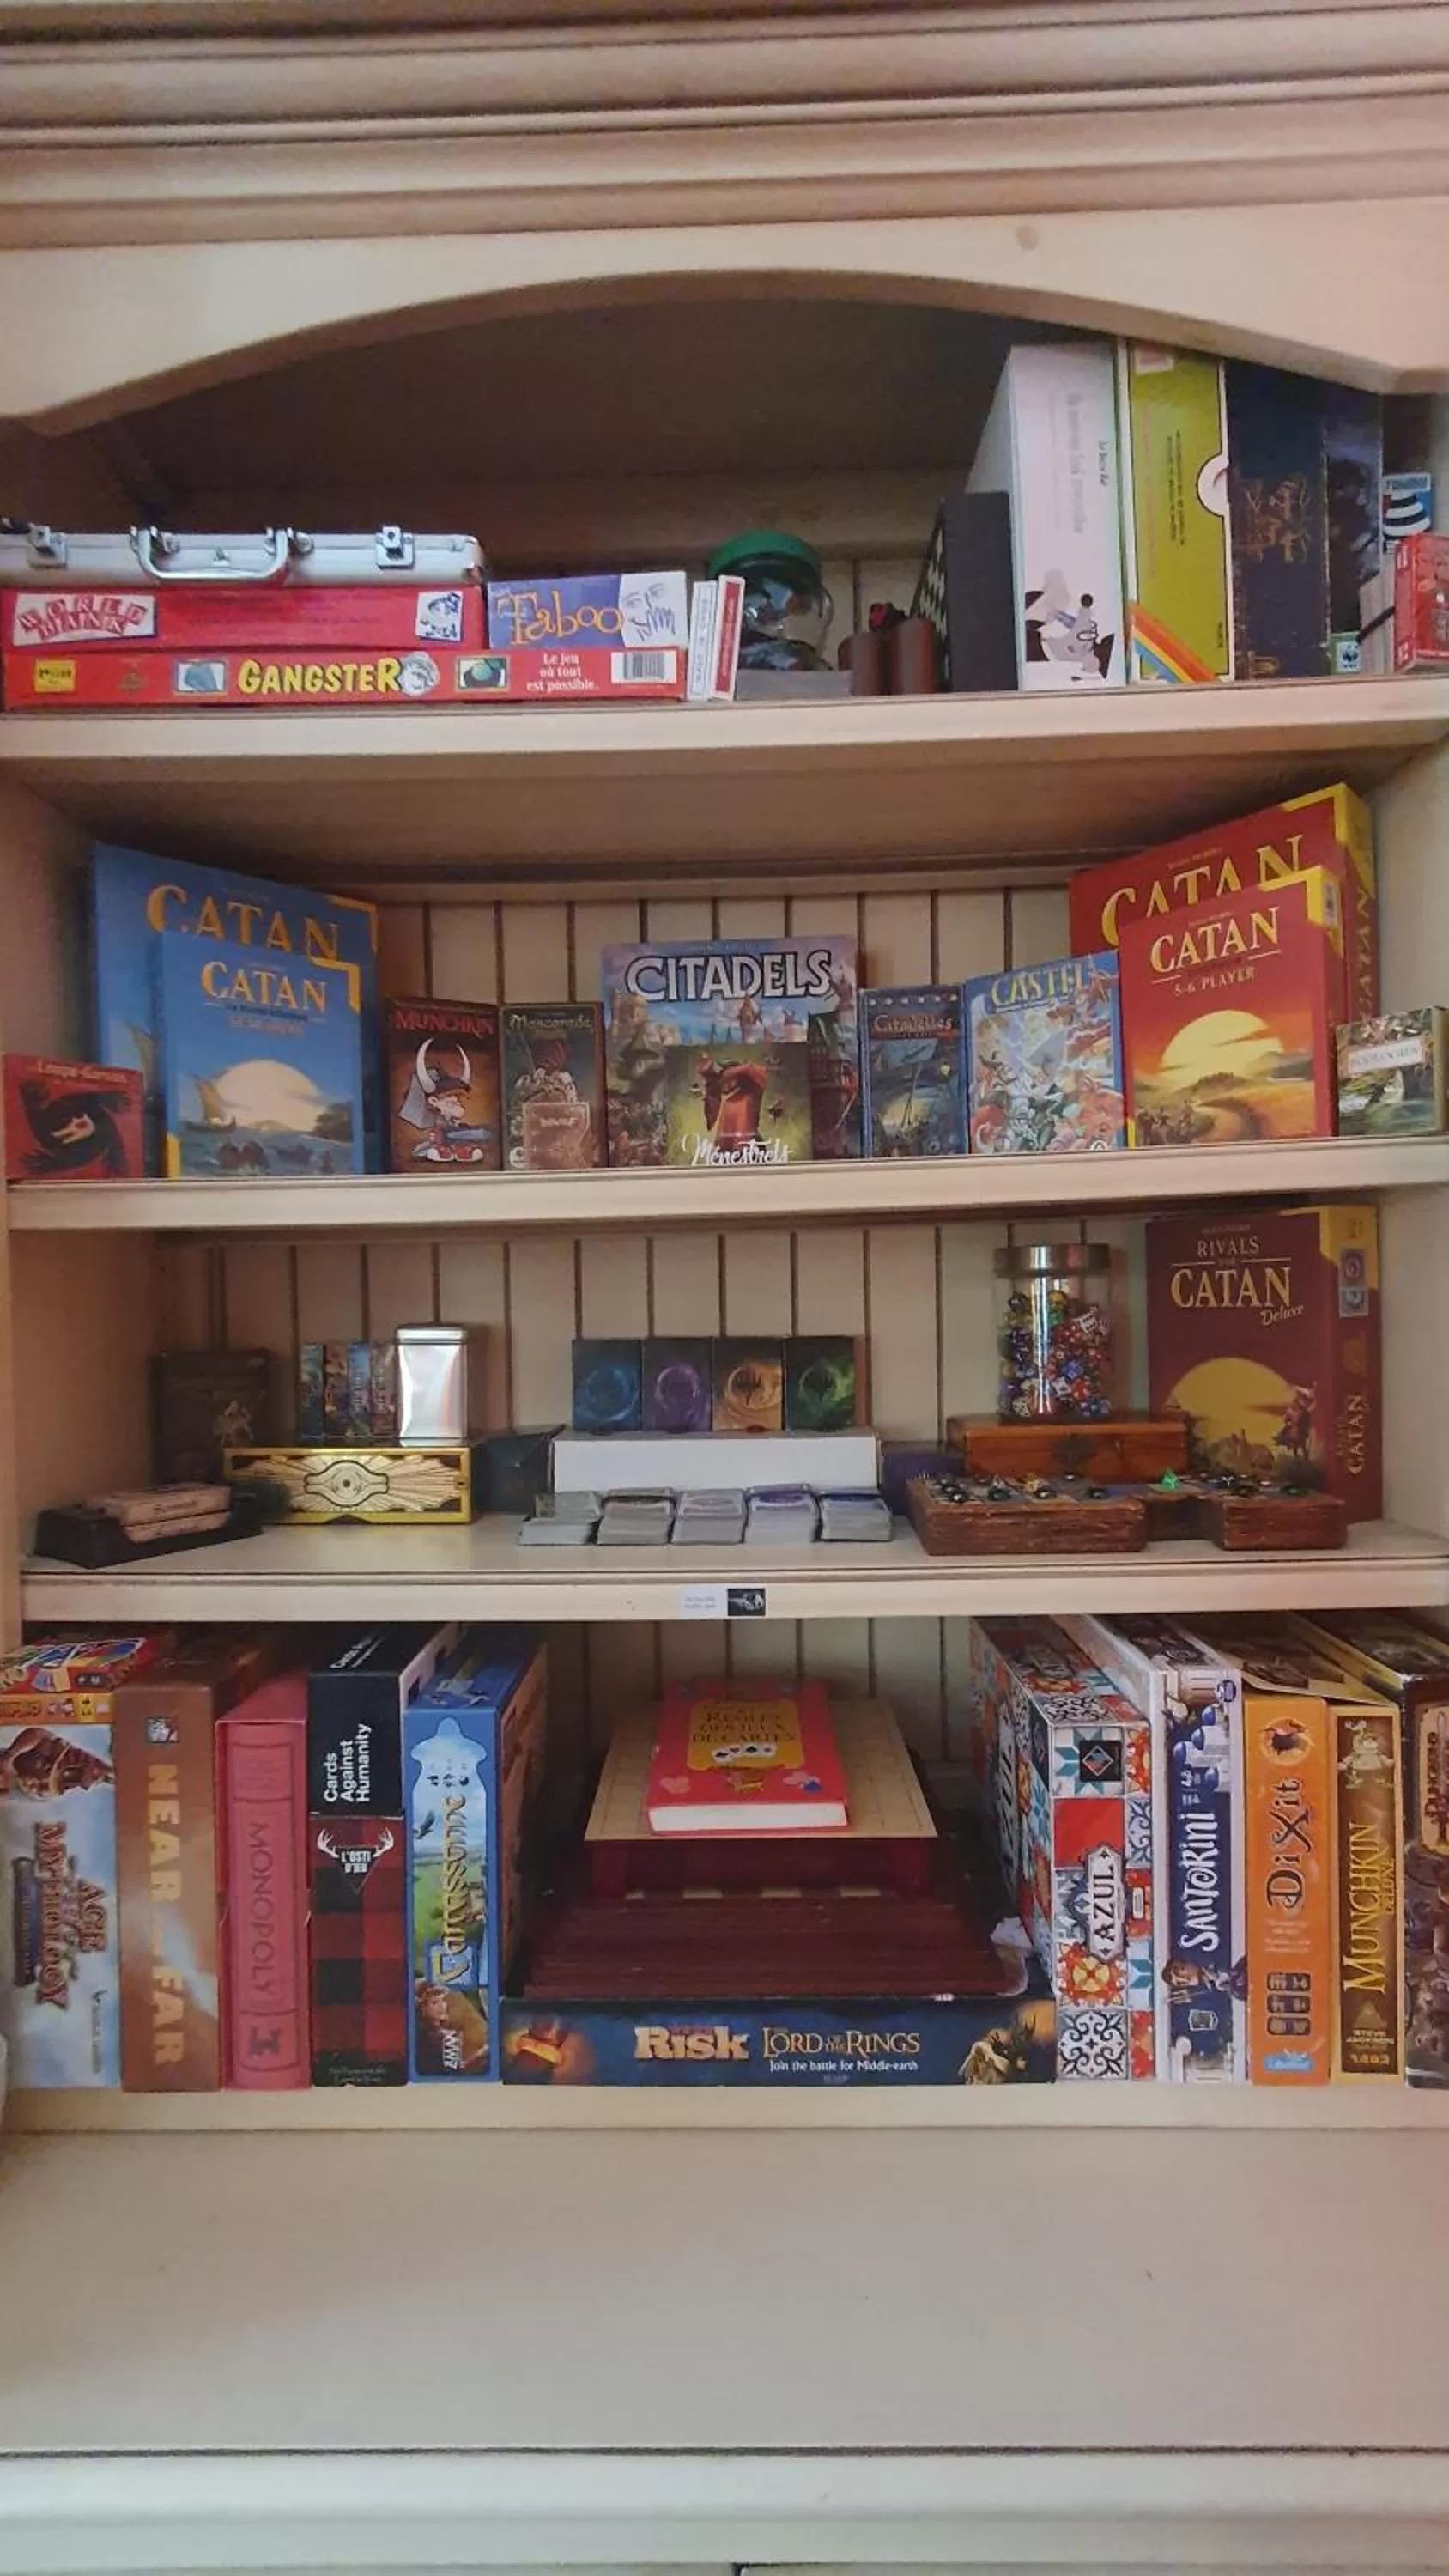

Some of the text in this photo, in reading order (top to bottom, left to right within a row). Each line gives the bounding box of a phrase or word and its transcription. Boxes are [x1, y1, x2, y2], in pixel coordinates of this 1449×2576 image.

[497, 590, 623, 646] Taboo
[238, 656, 403, 695] GANGSTER
[526, 682, 544, 691] est
[543, 653, 579, 667] Le jeu
[557, 667, 582, 677] tout
[1102, 834, 1303, 948] CATAN
[147, 884, 341, 959] CATAN
[1150, 906, 1280, 974] CATAN
[201, 961, 328, 1013] CATAN
[626, 950, 835, 1003] CITADELS
[1174, 966, 1255, 997] 5-6 PLAYER
[392, 1008, 496, 1040] MUNCHKIN
[1197, 1236, 1261, 1258] RIVALS
[1170, 1267, 1292, 1309] CATAN
[1346, 1394, 1366, 1475] CATAN
[324, 1752, 338, 1802] Cards
[341, 1741, 357, 1802] Against
[355, 1723, 372, 1802] Humanity
[147, 1764, 181, 1903] NEAR
[33, 1820, 69, 2011] MYTHOLOGY
[78, 1878, 106, 1953] AGE
[246, 1822, 277, 2005] MONOPOLY
[1094, 1861, 1115, 1941] AZUL
[1343, 1820, 1387, 1994] MUNCHKIN
[153, 1975, 186, 2065] FAR
[634, 2026, 750, 2063] Risk
[762, 2026, 822, 2058] LORD
[846, 2030, 920, 2058] RINGS
[769, 2060, 919, 2072] Join the battle for Middle-earth
